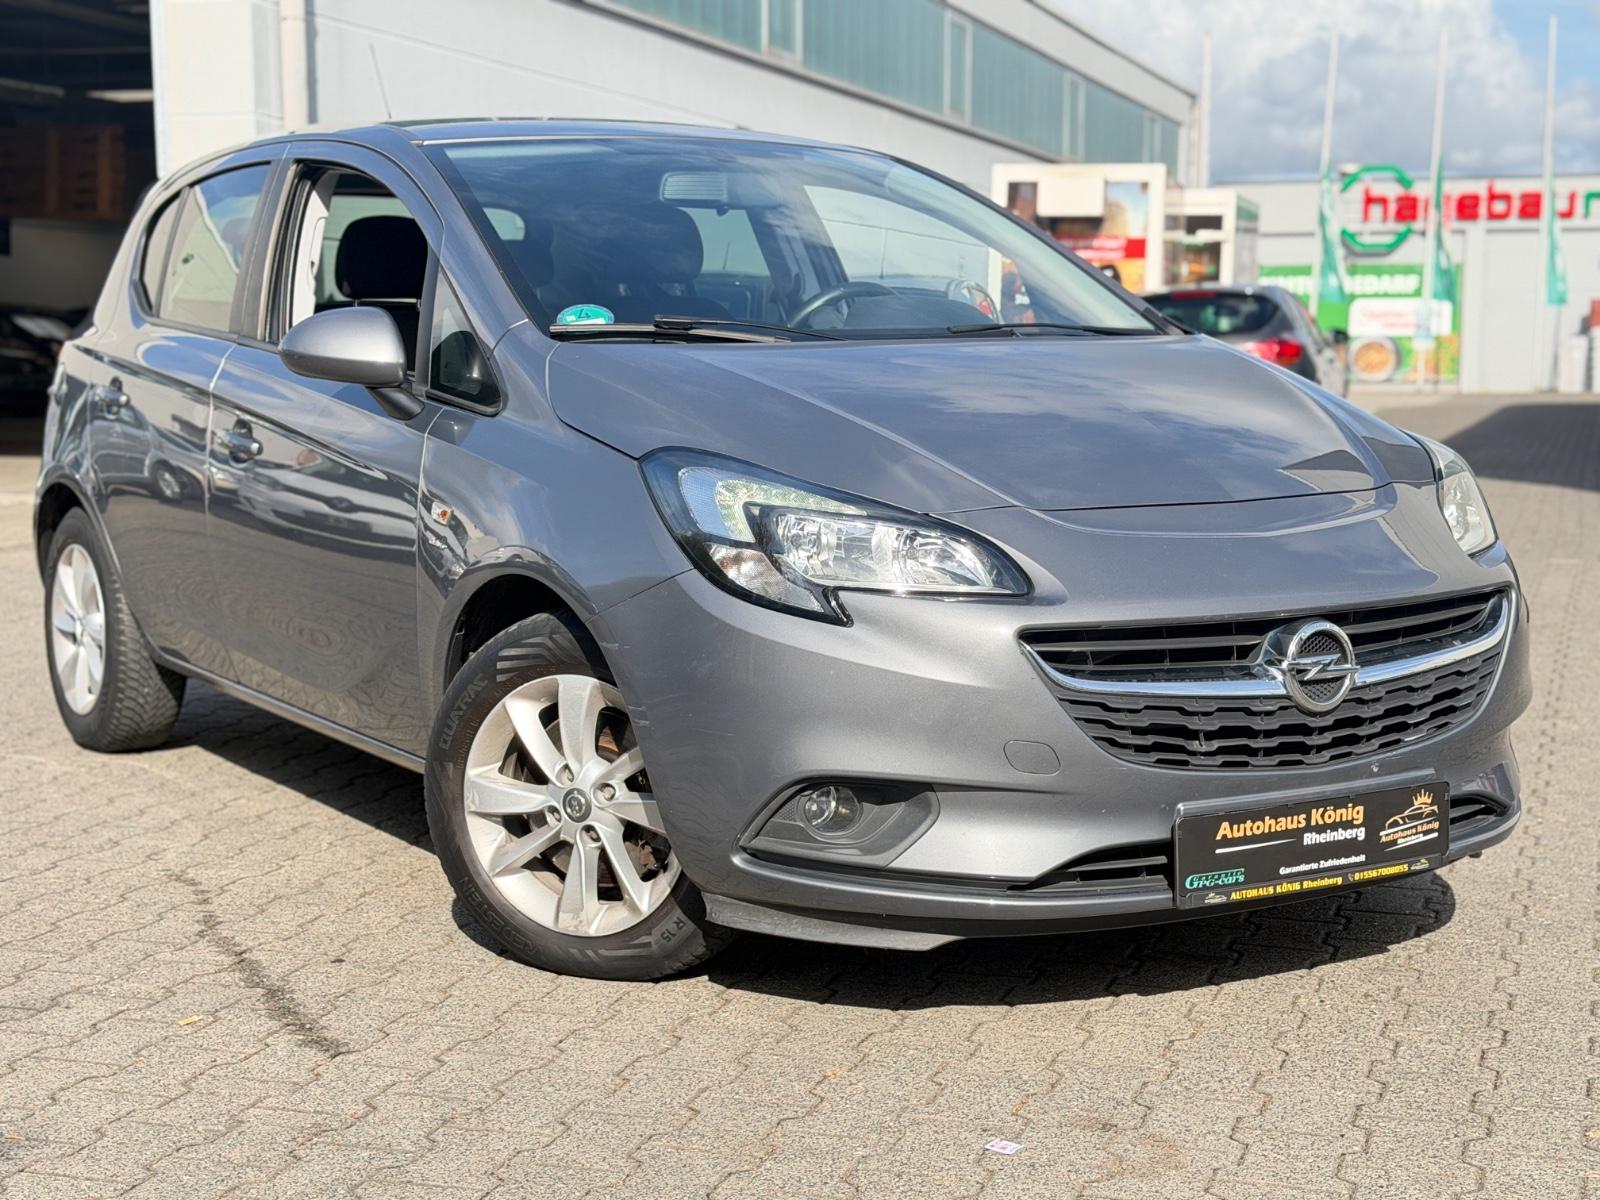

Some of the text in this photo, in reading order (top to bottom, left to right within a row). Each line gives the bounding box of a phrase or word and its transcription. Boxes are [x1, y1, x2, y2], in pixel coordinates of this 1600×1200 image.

[1215, 803, 1364, 840] Autohaus König
[1380, 820, 1440, 843] Autohaus König
[1303, 826, 1366, 846] Rheinberg
[1279, 854, 1366, 875] Garantierte Zufriedenheit
[1230, 886, 1274, 900] AUTOHAUS
[1276, 881, 1301, 894] KÖNIG
[1302, 876, 1343, 889] Rheinberg
